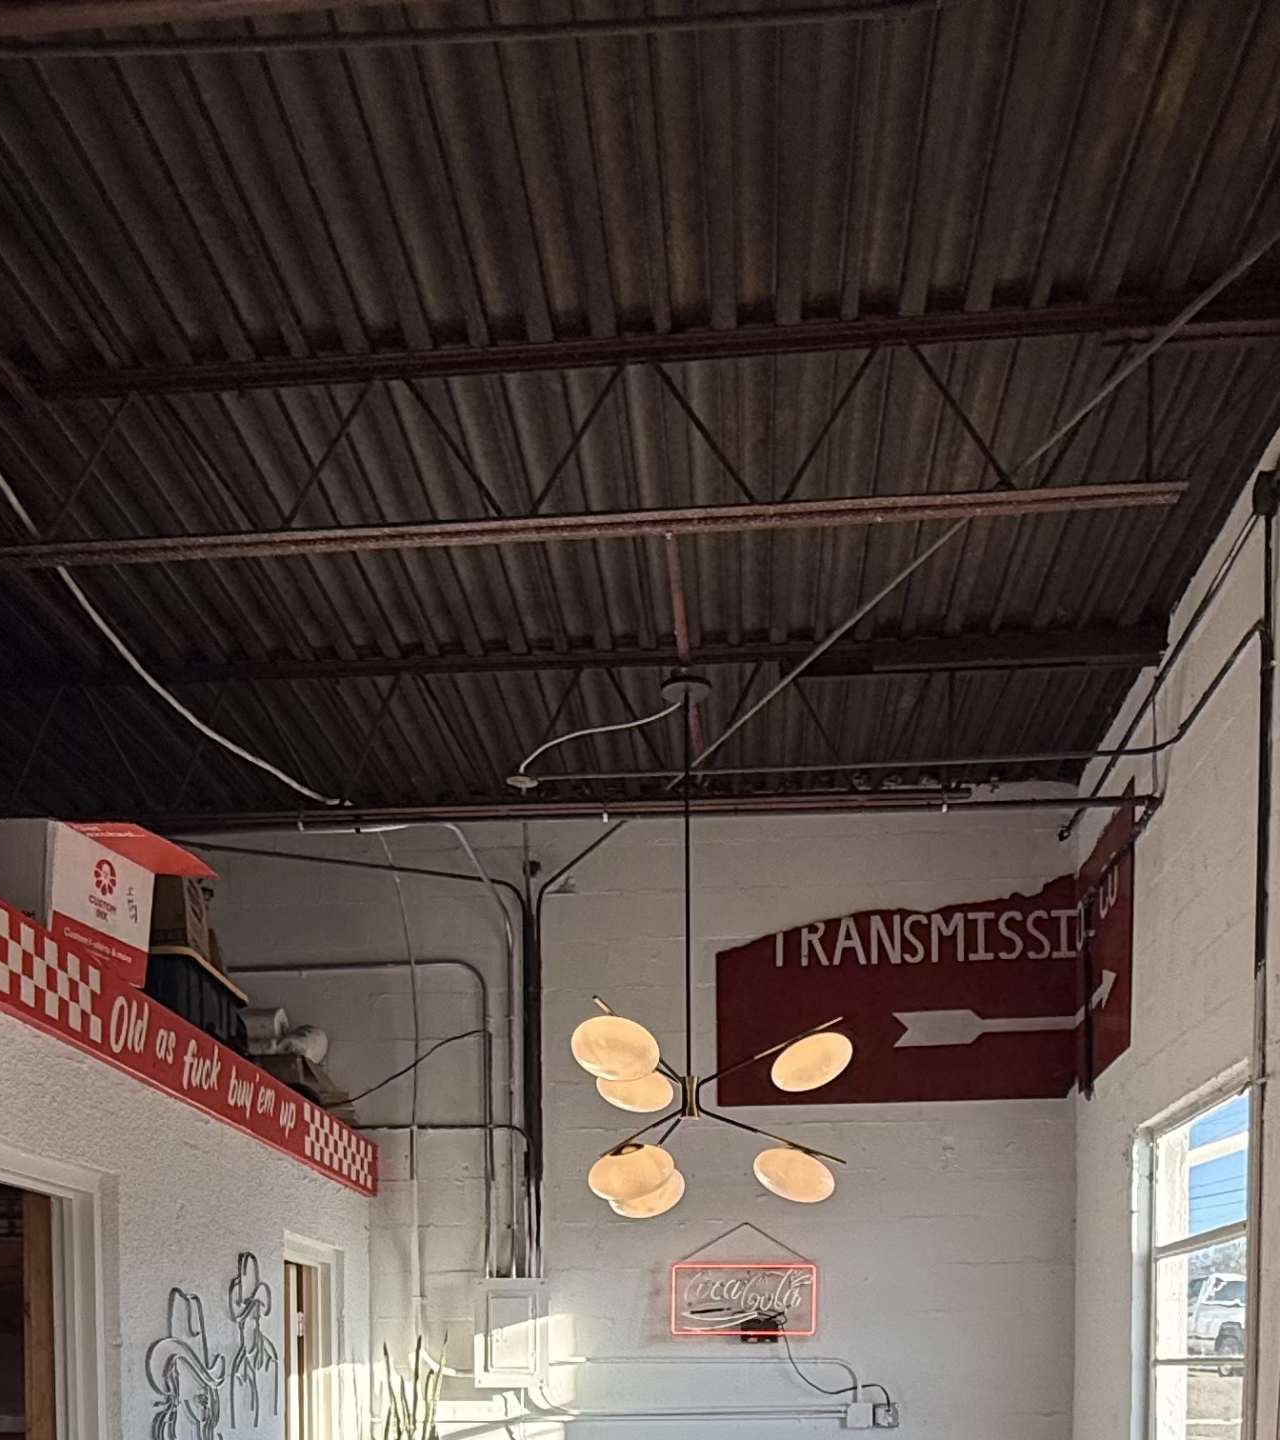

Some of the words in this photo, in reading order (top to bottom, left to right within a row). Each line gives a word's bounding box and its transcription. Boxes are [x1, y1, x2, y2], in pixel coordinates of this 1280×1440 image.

[775, 900, 1096, 968] RANSMISSIO
[109, 995, 149, 1054] Old
[155, 1025, 177, 1064] as
[182, 1039, 221, 1091] fuck
[279, 1100, 296, 1138] up
